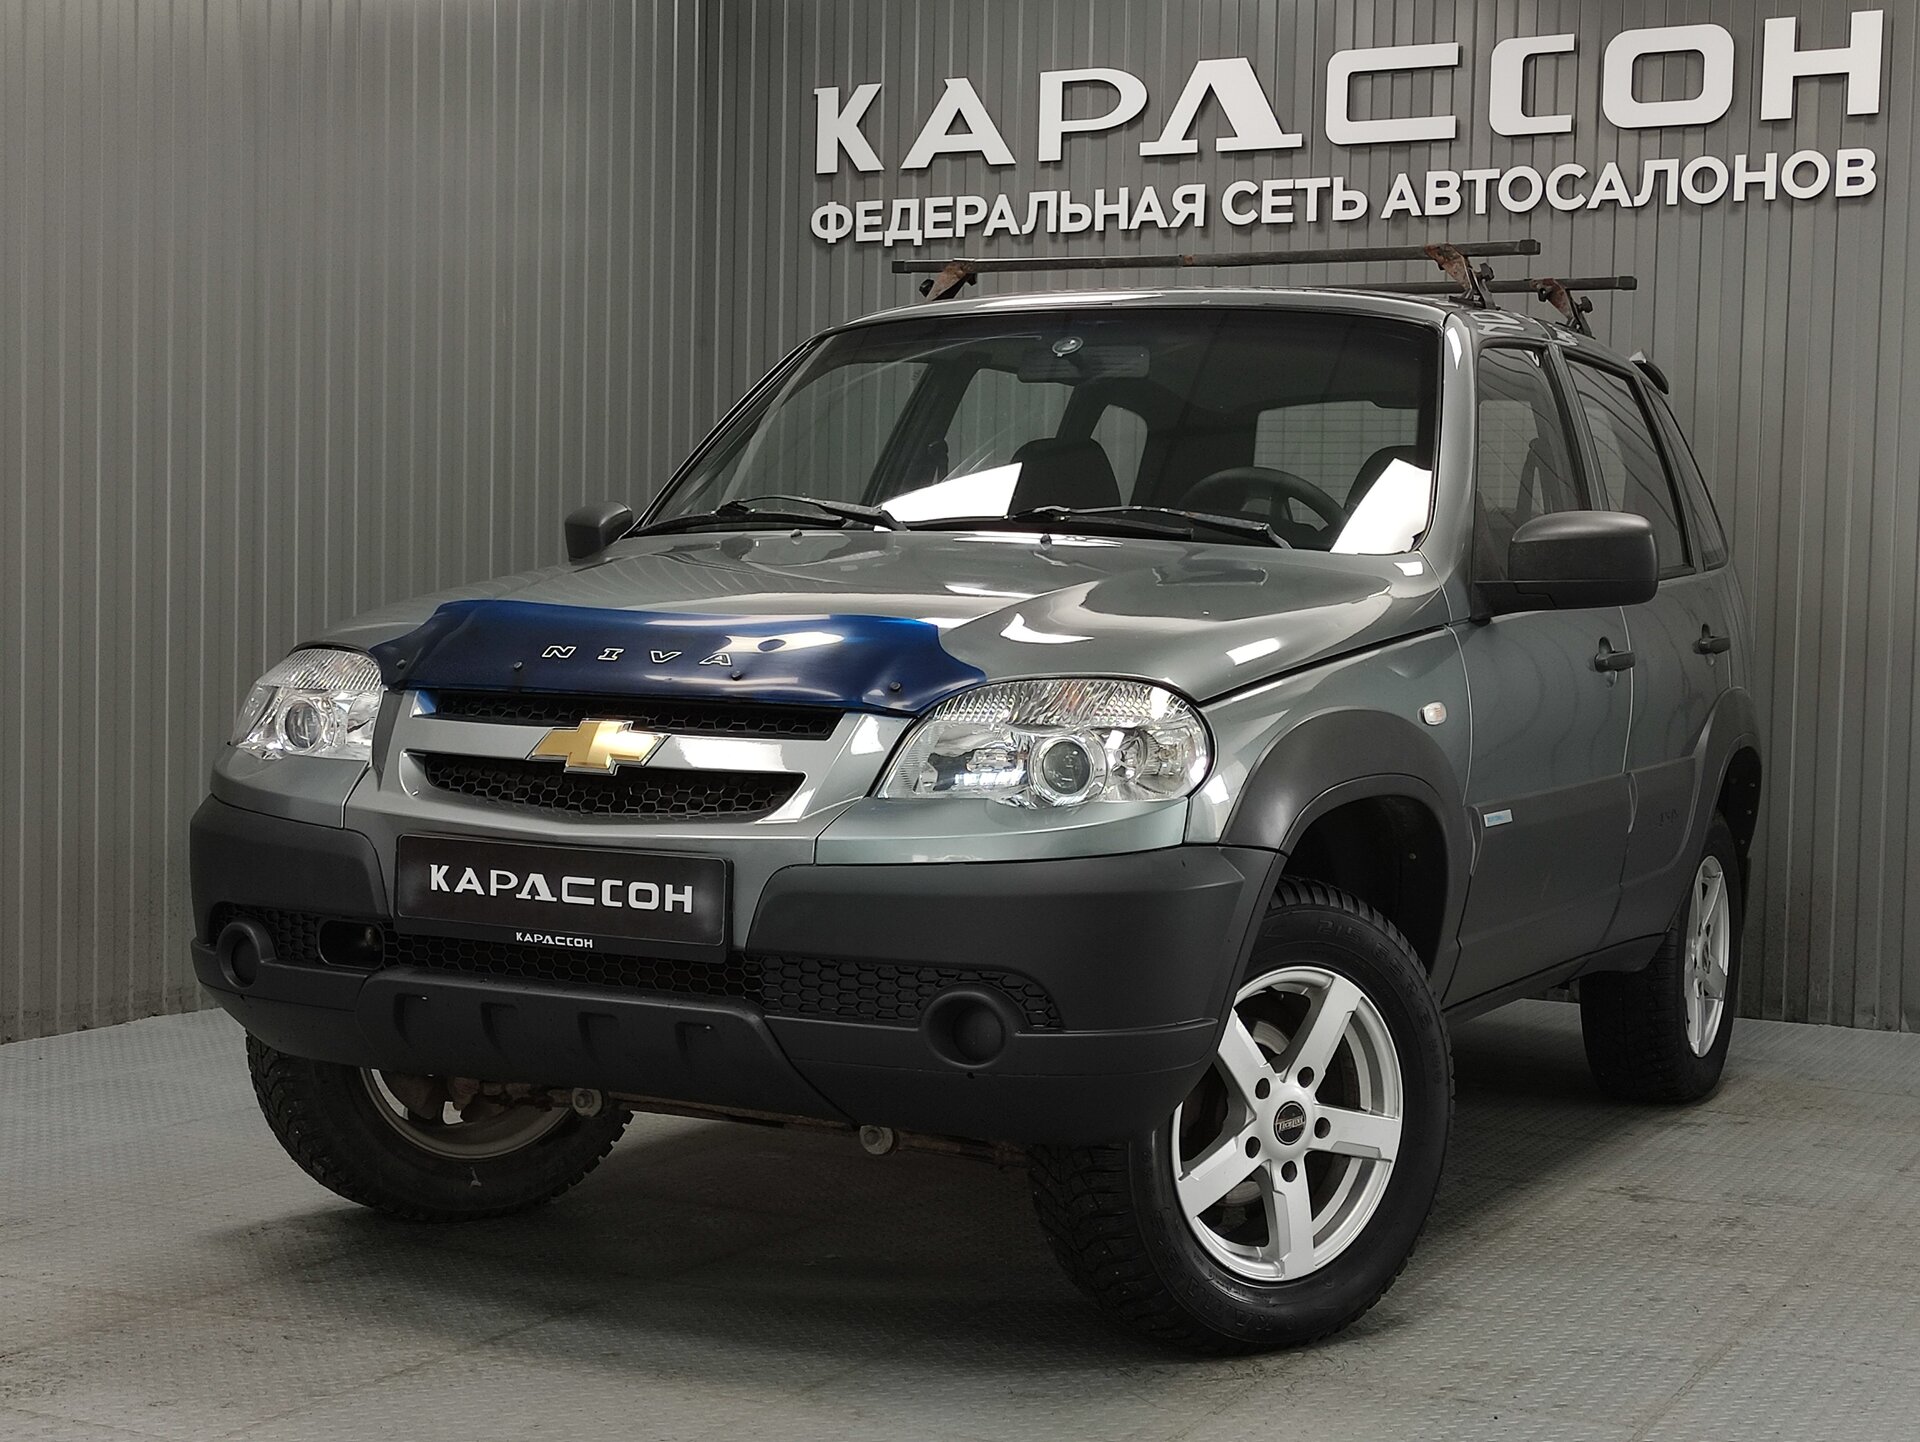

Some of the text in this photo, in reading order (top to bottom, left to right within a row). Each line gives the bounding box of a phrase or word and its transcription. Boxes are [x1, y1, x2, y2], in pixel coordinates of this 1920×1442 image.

[811, 149, 1877, 247] ФЕДЕРАЛЬНАЯ СЕТЬ АВТОСАЛОНОВ
[541, 645, 732, 666] NIVA
